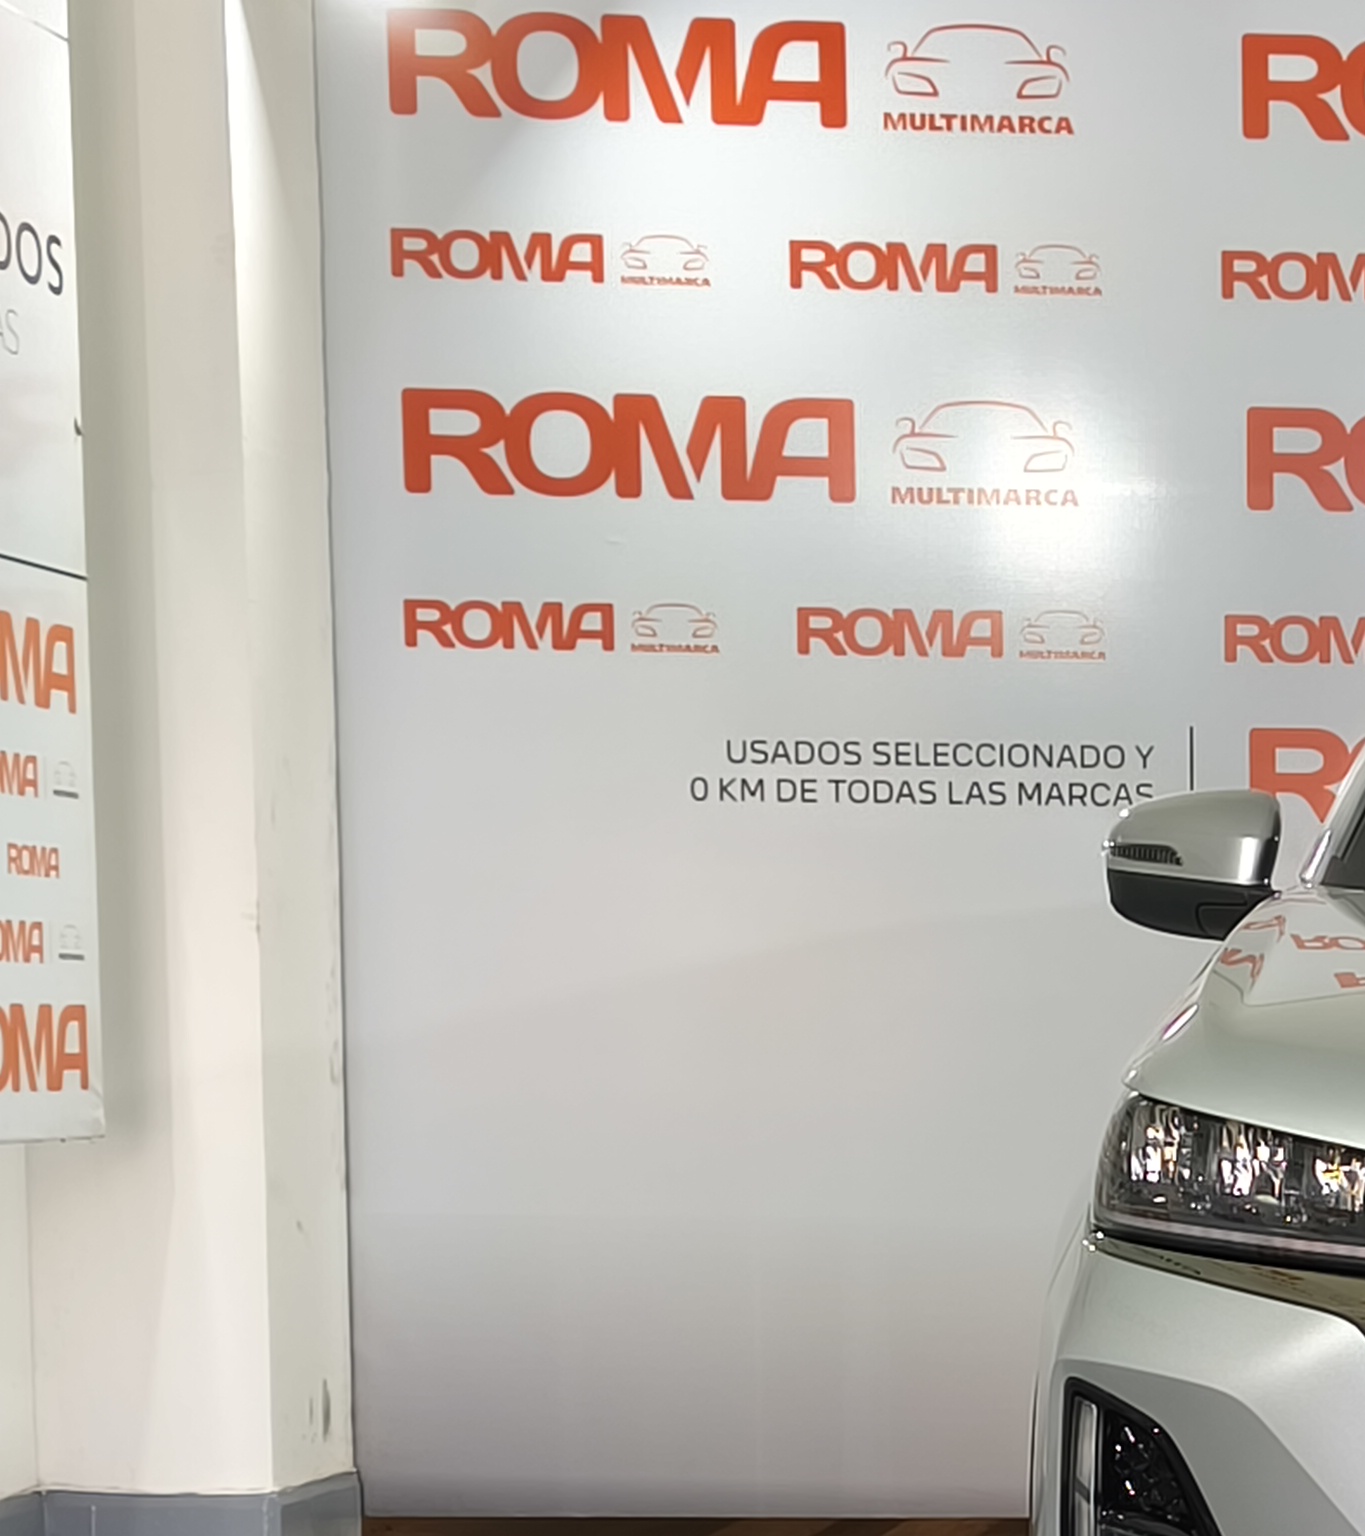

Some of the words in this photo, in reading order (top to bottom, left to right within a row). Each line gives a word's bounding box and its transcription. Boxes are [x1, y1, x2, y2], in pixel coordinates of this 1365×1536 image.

[389, 9, 848, 129] ROMA
[883, 113, 1074, 136] MULTIMARCA
[391, 230, 604, 284] ROMA
[790, 241, 998, 294] ROMA
[402, 389, 856, 503] ROMA
[891, 487, 1077, 507] MULTIMARCA
[404, 600, 615, 652] ROMA
[797, 608, 1004, 659] ROMA
[727, 740, 861, 765] USADOS
[873, 742, 1125, 769] SELECCIONADO
[1135, 746, 1154, 769] Y
[690, 777, 708, 801] 0
[719, 778, 764, 802] KM
[777, 779, 817, 803] DE
[828, 779, 936, 804] TODAS
[949, 781, 1006, 805] LAS
[1018, 782, 1153, 806] MARCAS
[8, 844, 60, 878] ROMA
[0, 922, 43, 964] MA
